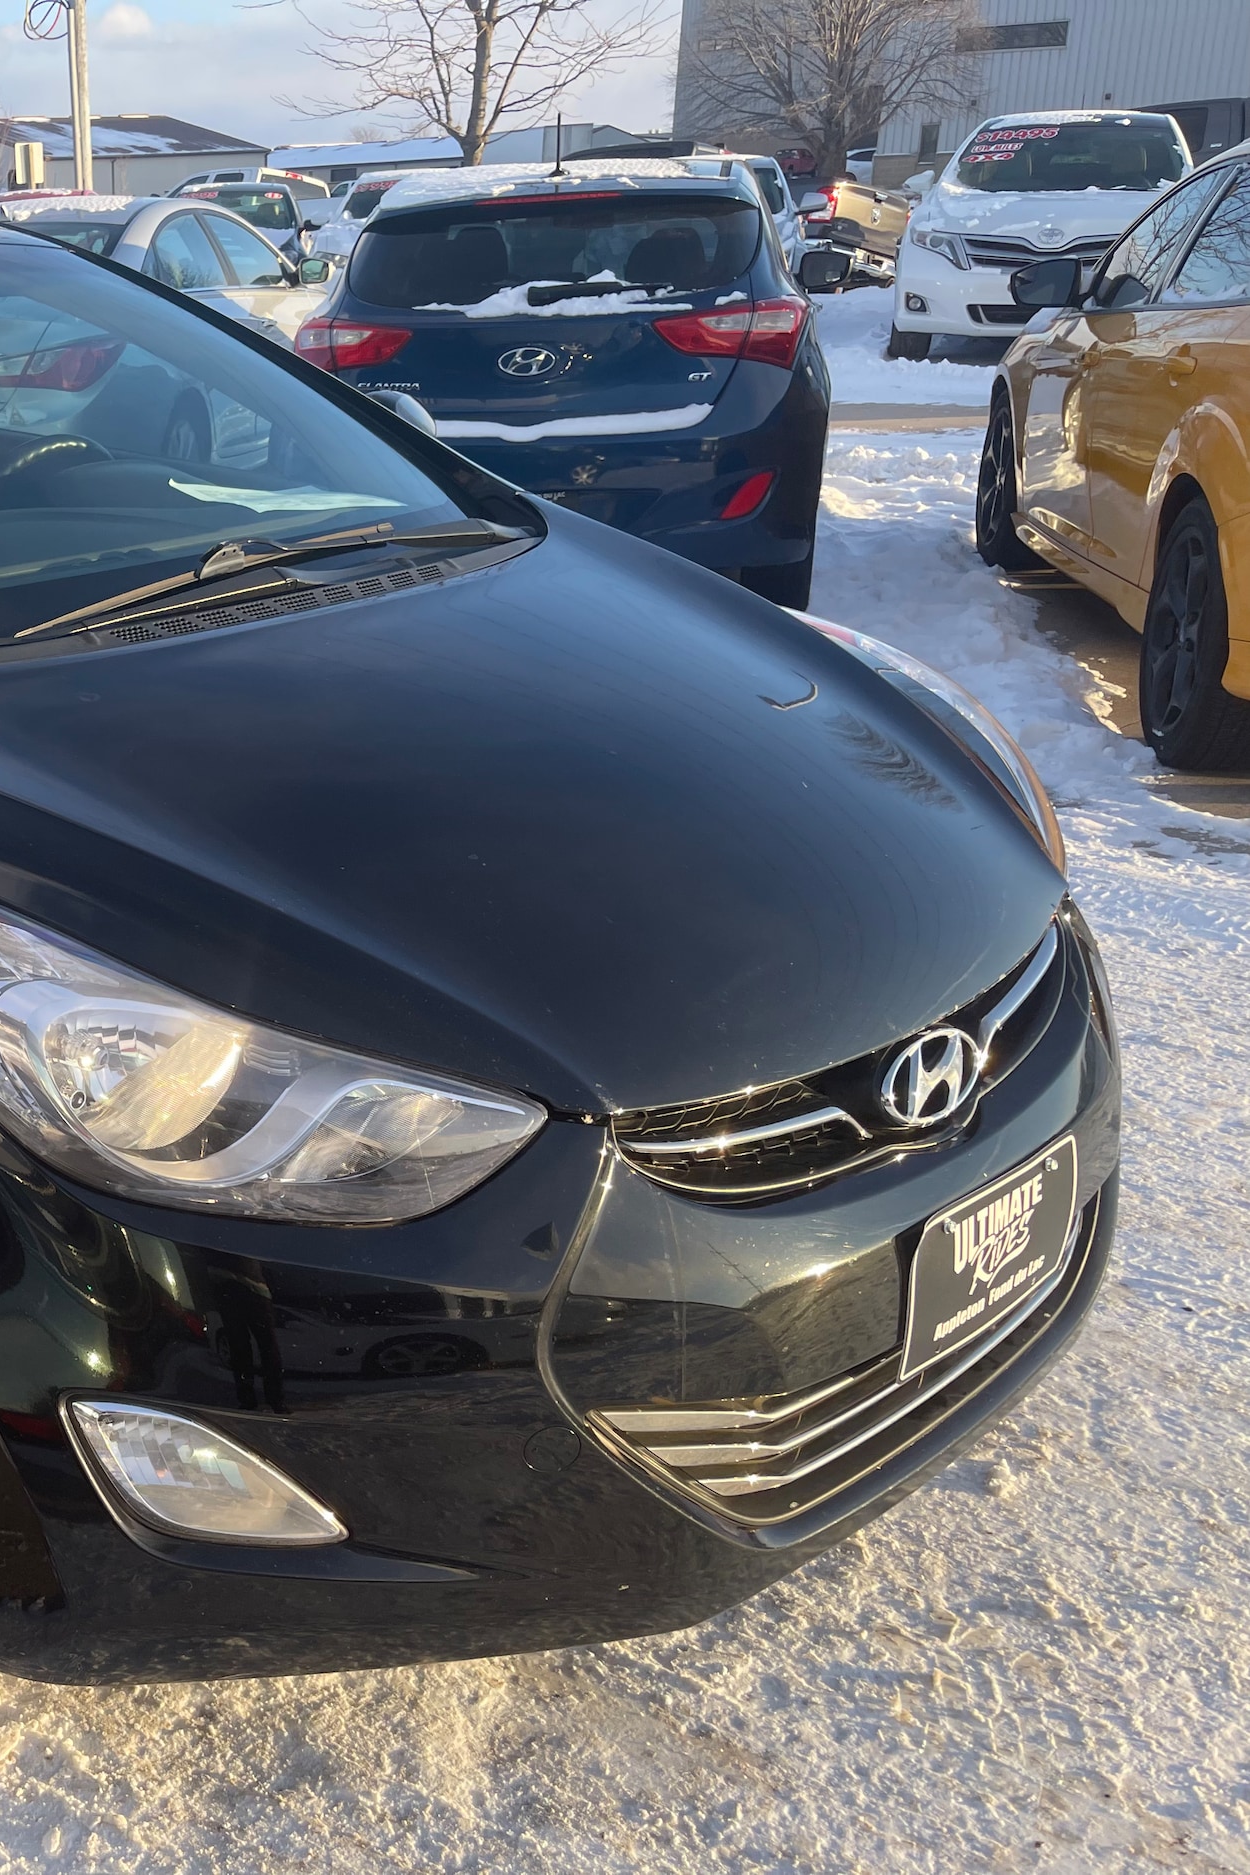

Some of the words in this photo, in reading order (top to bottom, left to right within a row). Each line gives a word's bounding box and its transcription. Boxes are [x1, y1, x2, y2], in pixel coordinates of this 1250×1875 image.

[975, 128, 1060, 143] $14495
[972, 145, 991, 153] LOW
[993, 143, 1023, 151] MILES
[687, 371, 712, 382] GT
[357, 382, 421, 391] ELANTRA
[953, 1172, 1043, 1274] ULTIMATE
[933, 1297, 986, 1341] Appleton
[988, 1275, 1014, 1306] Fond
[1013, 1267, 1028, 1287] du
[1027, 1254, 1046, 1277] Lac
